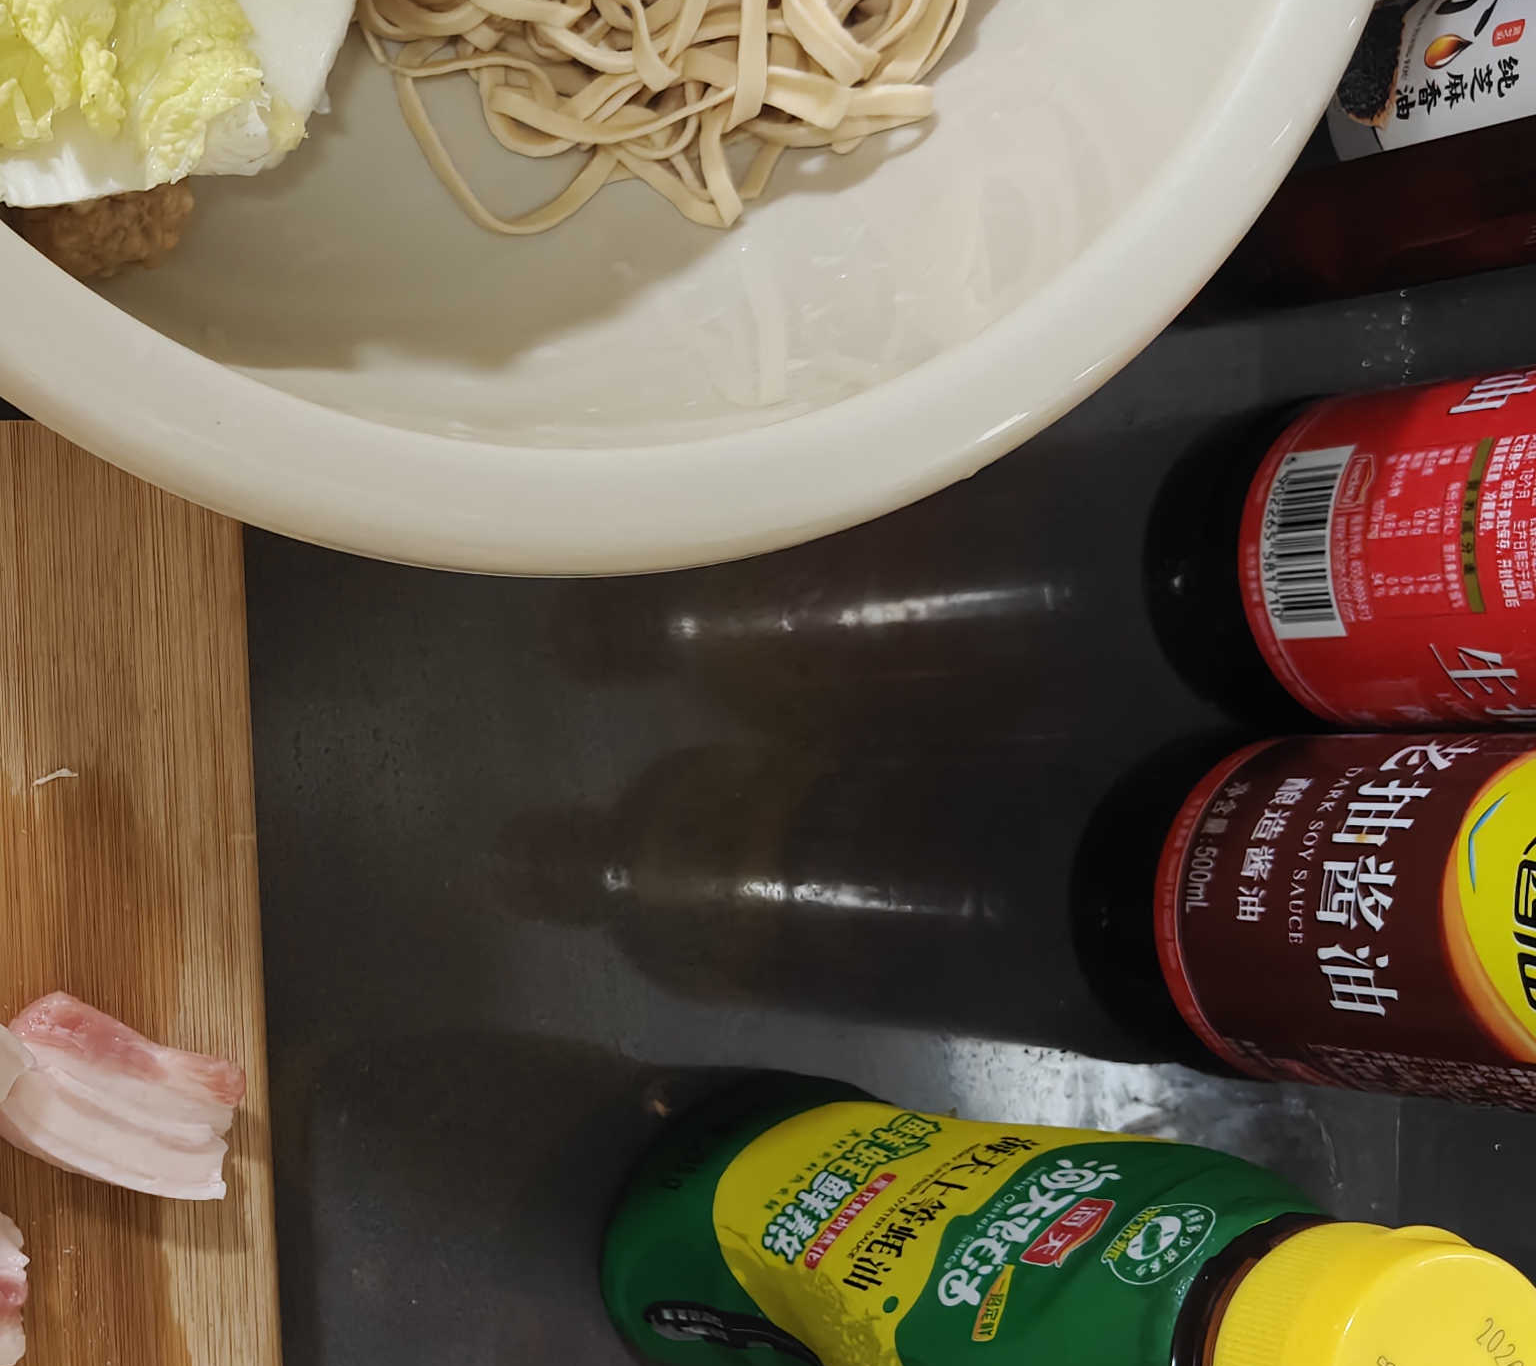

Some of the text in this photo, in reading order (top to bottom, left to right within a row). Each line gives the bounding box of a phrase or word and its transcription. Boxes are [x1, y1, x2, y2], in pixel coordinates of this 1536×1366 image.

[1395, 56, 1520, 120] 纯芝麻香油
[1236, 777, 1313, 922] 酿造酱油
[1288, 767, 1363, 945] DARK SOY SAUCE
[1316, 738, 1479, 1017] 老抽酱油
[761, 1113, 942, 1264] 鲜蚝鲜熬
[843, 1137, 1040, 1291] 海天上等蚝油
[938, 1159, 1122, 1306] 海天蚝油
[944, 1234, 975, 1270] Sauce
[976, 1193, 1015, 1232] Oyster
[1036, 1206, 1102, 1256] 海天
